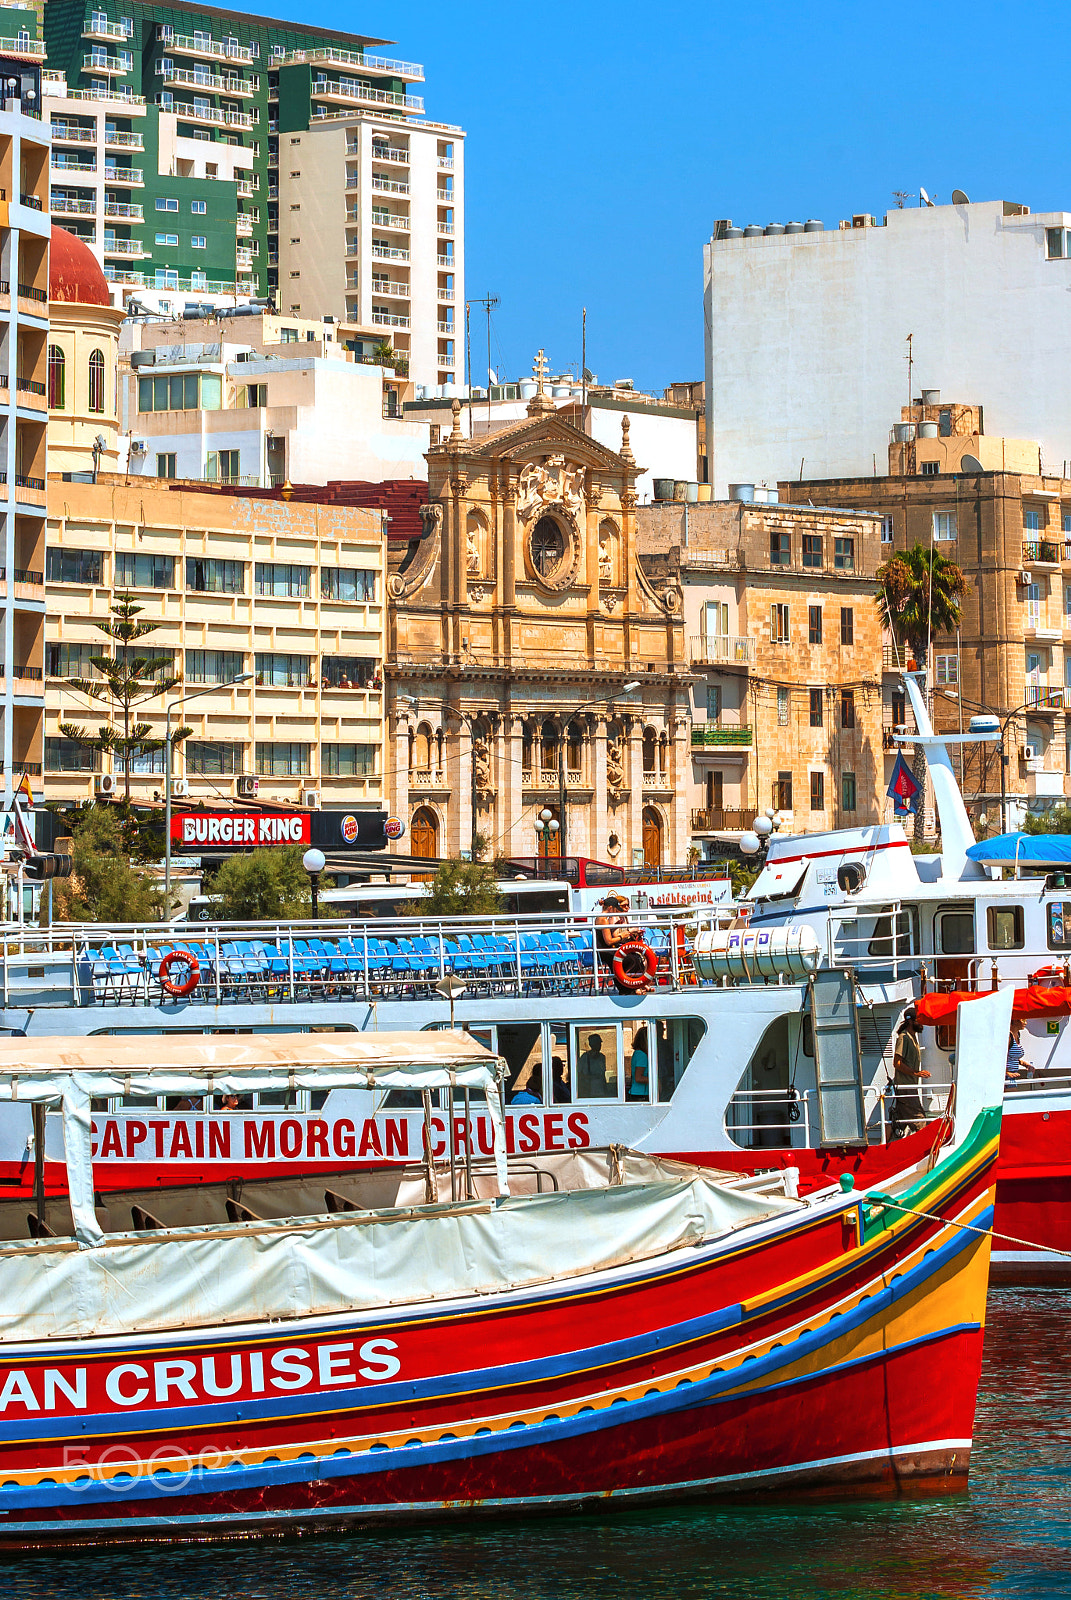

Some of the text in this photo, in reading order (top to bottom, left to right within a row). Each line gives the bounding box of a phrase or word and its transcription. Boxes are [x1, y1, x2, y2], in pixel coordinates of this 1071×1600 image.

[183, 817, 303, 842] BURGER KING
[656, 889, 714, 905] sightseeing
[729, 933, 770, 947] RFD
[243, 1118, 409, 1159] MORGAN
[421, 1111, 591, 1158] CRUISES
[105, 1338, 402, 1406] CRUISES
